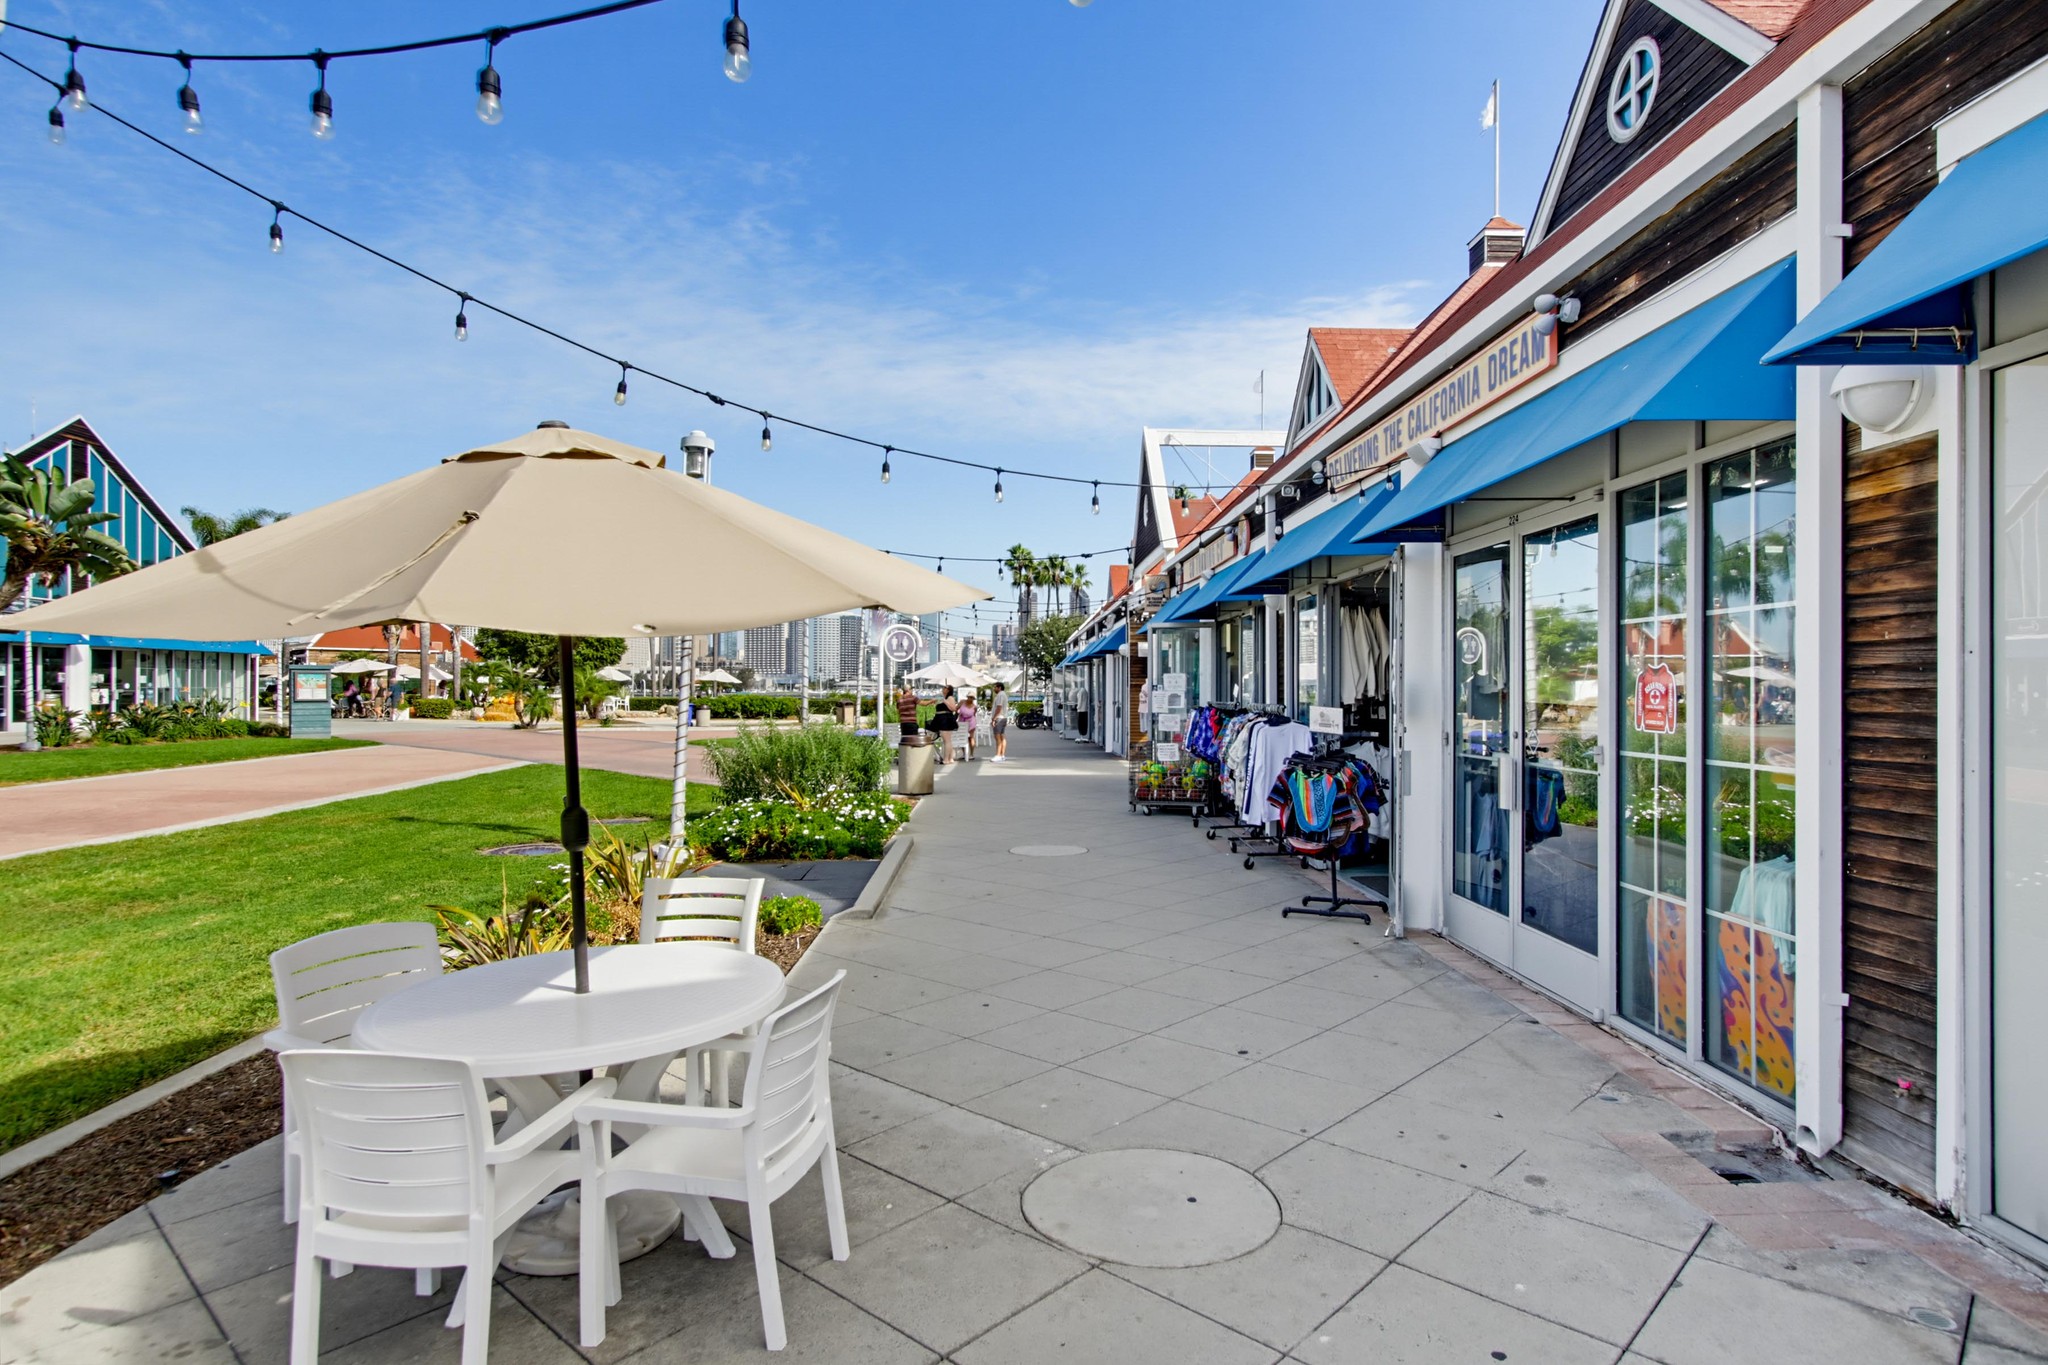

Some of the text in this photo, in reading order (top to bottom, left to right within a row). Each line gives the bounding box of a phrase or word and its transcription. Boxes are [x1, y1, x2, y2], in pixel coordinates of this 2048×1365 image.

[1328, 326, 1545, 486] DELIVERING THE CALIFORNIA DREAM
